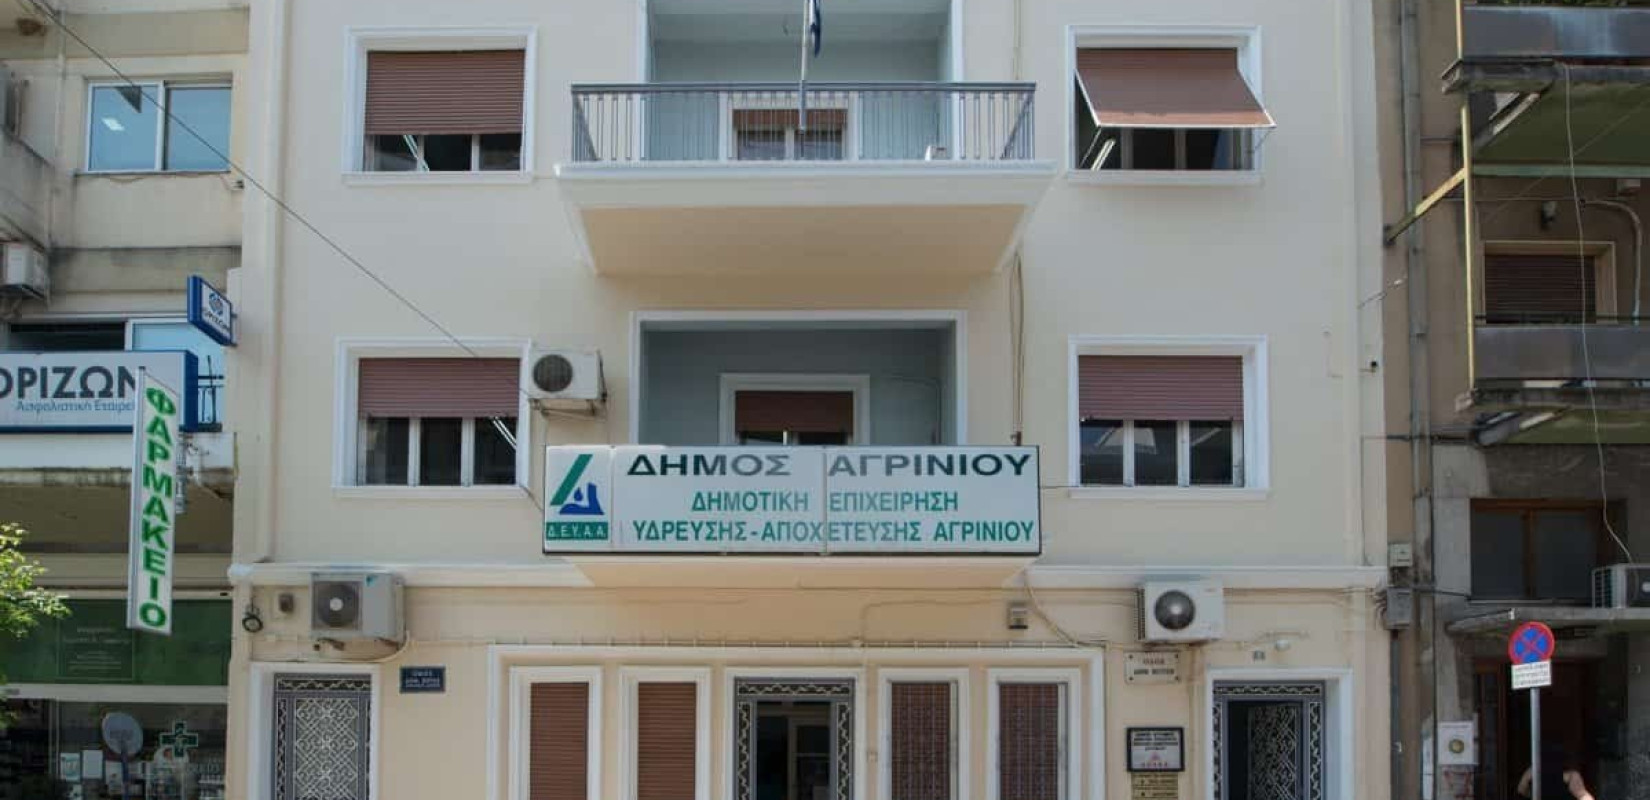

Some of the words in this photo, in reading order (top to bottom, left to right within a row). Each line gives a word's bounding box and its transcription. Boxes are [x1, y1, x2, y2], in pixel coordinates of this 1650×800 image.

[627, 454, 791, 476] ΔΗΜΟΣ
[828, 454, 1031, 476] ΑΓΡΙΝΙΟΥ
[139, 387, 176, 628] ΦΑΡΜΑΚΕΙΟ
[691, 491, 809, 512] ΔΗΜΟΤΙΚΗ
[829, 491, 958, 512] ΕΠΙΧΕΙΡΗΣΗ
[933, 521, 1034, 542] ΑΓΡΙΝΙΟΥ
